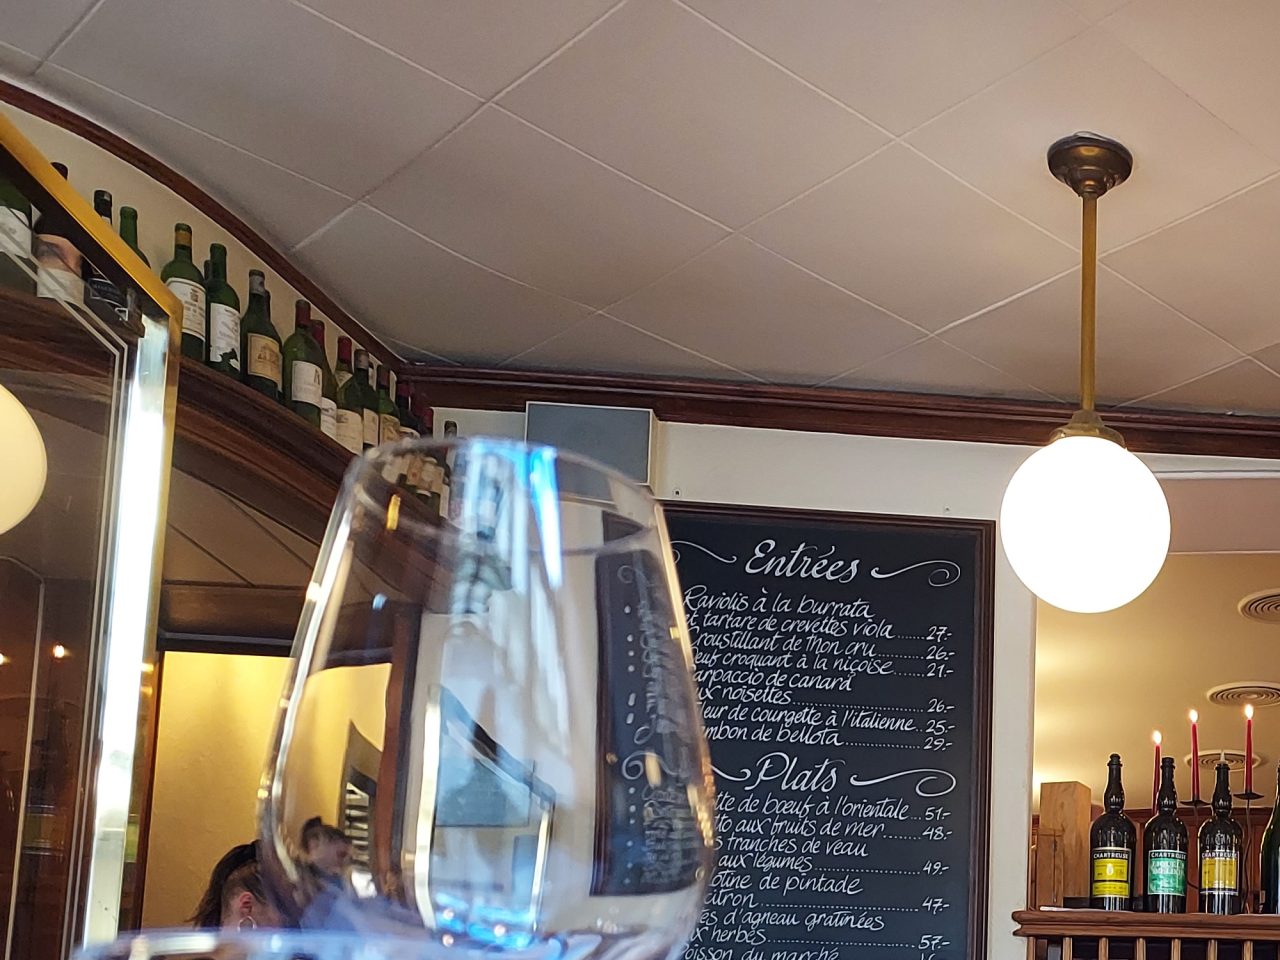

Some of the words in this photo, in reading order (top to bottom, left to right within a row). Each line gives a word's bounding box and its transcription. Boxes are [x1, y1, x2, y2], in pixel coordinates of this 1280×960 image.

[745, 539, 860, 583] Entrées
[683, 585, 749, 611] Raviolis
[752, 587, 768, 612] à
[772, 592, 792, 612] la
[797, 594, 876, 618] burrata
[703, 611, 757, 629] tartare
[758, 614, 778, 631] de
[781, 616, 848, 637] crevettes
[853, 618, 896, 639] viola
[782, 635, 803, 651] de
[806, 633, 844, 655] thon
[845, 641, 877, 657] cru
[692, 663, 765, 687] arpaccio
[765, 670, 788, 687] de
[788, 673, 852, 691] canard
[722, 651, 793, 670] croquant
[796, 654, 808, 668] à
[813, 654, 828, 670] la
[833, 656, 894, 680] niçoise
[722, 685, 792, 705] noisettes
[728, 703, 749, 721] de
[751, 705, 823, 728] courgette
[825, 710, 838, 727] à
[841, 709, 917, 732] l'italienne
[751, 724, 773, 741] de
[776, 724, 844, 745] bellota
[744, 751, 846, 793] Plats
[737, 793, 760, 813] de
[815, 795, 830, 816] à
[834, 795, 910, 820] l'orientale
[735, 818, 772, 835] aux
[770, 815, 817, 837] fruits
[820, 817, 842, 837] de
[844, 822, 885, 838] mer
[727, 832, 798, 854] tranches
[801, 836, 821, 854] de
[826, 839, 868, 857] veau
[1093, 851, 1129, 860] CHARTREUSE
[1151, 850, 1186, 859] CHARTREUSE
[718, 852, 754, 868] aux
[753, 851, 813, 873] légumes
[759, 872, 781, 890] de
[783, 873, 863, 896] pintade
[704, 888, 759, 908] citron
[723, 908, 800, 930] d'agneau
[804, 910, 885, 932] gratinées
[710, 925, 767, 945] herbes
